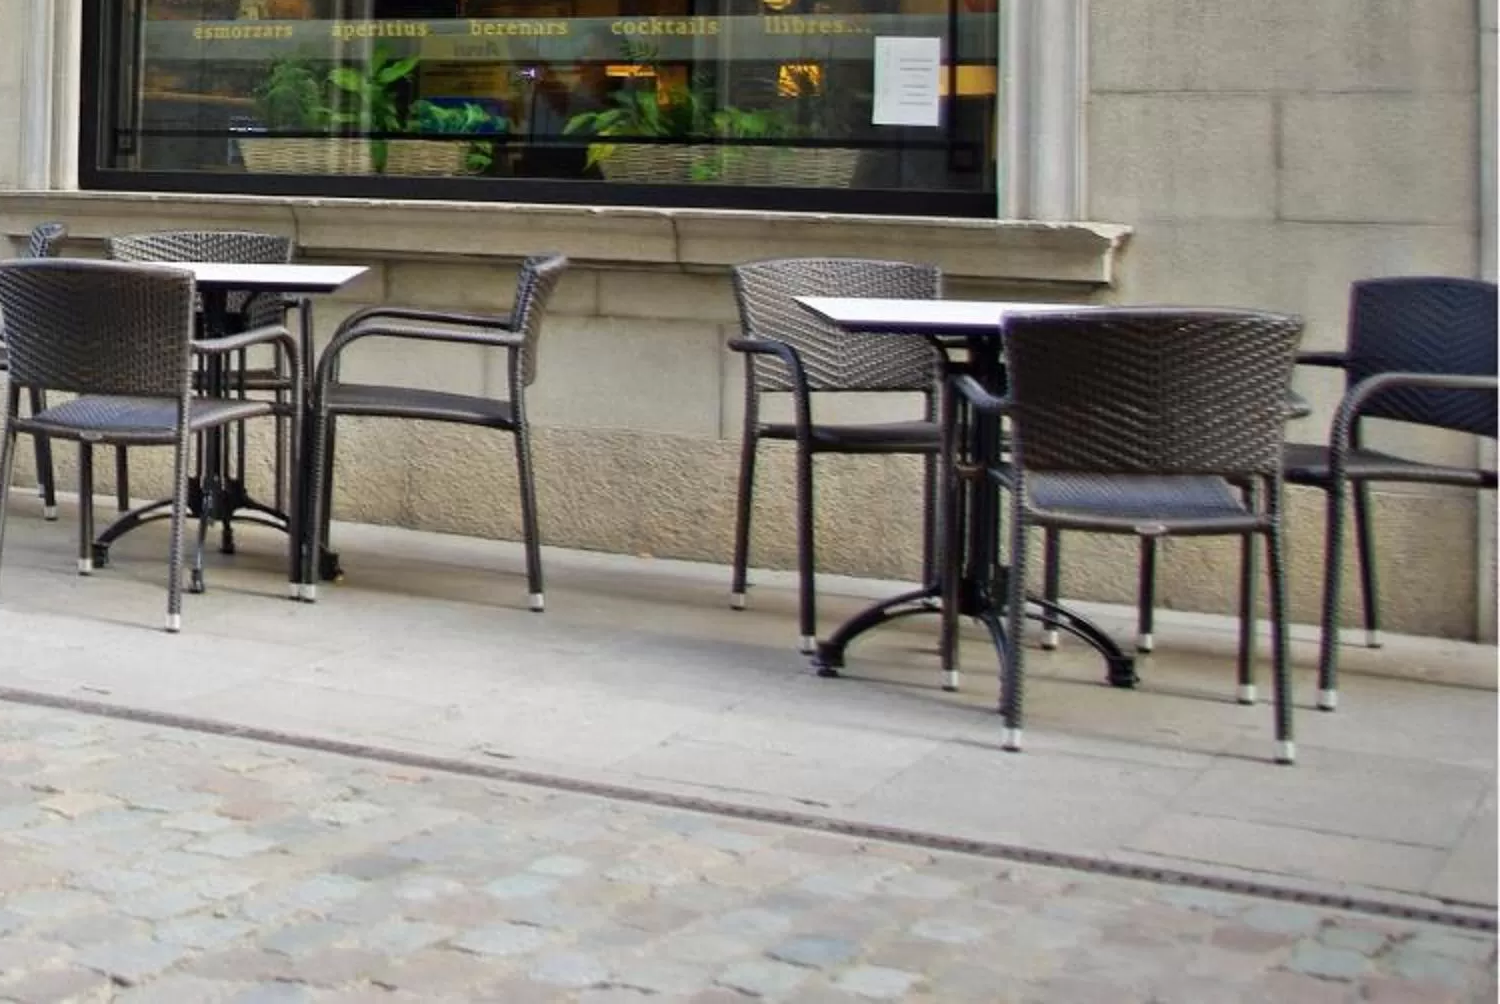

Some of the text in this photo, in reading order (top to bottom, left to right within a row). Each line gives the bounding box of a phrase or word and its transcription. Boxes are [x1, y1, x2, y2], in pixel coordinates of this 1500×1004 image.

[193, 24, 293, 40] esmorzars
[331, 20, 428, 41] aperitius
[470, 20, 568, 36] berenars
[611, 16, 721, 36] cocktails
